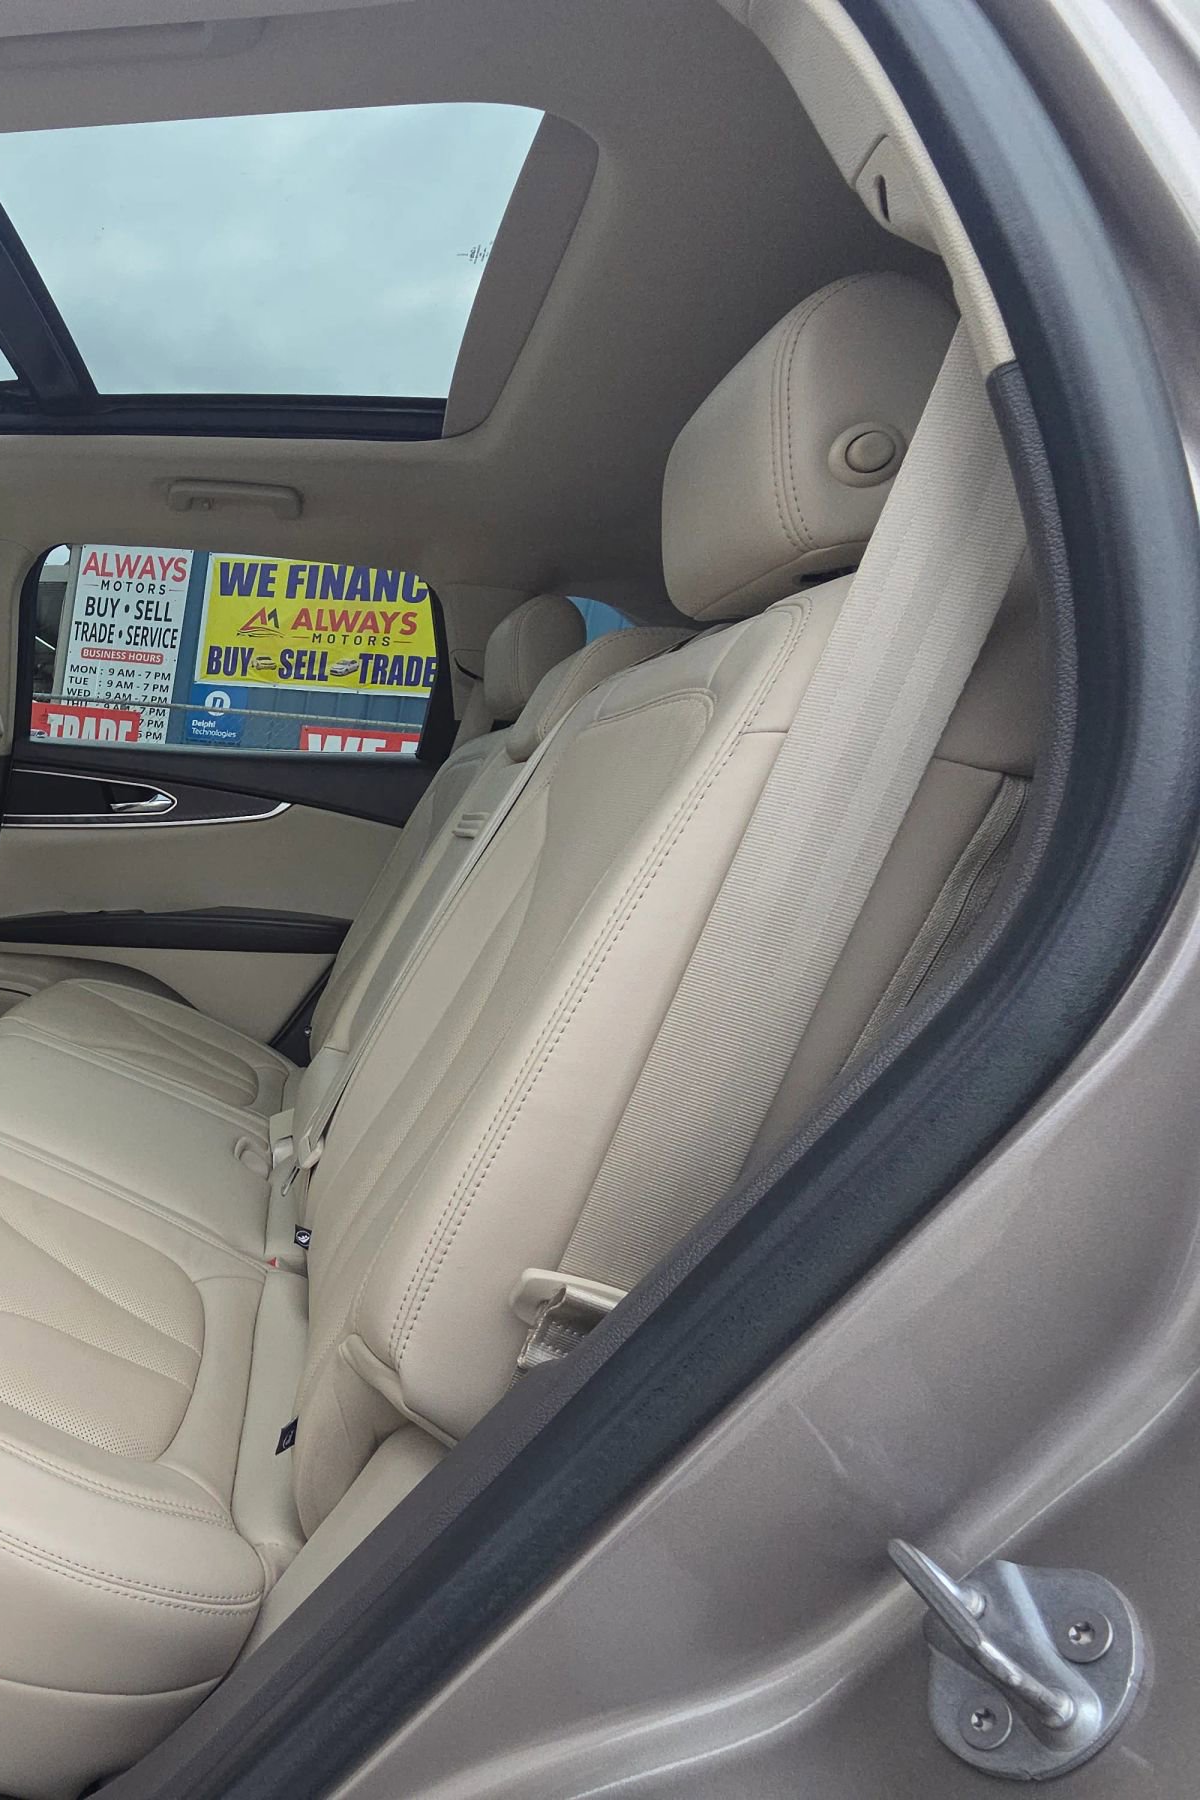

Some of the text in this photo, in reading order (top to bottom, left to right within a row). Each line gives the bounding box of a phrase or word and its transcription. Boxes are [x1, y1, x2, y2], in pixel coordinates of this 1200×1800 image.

[82, 552, 188, 582] ALWAYS
[101, 580, 166, 595] MOTORS
[219, 561, 428, 604] WE FINANC
[84, 596, 172, 622] BUY SELL
[290, 607, 418, 636] ALWAYS
[74, 621, 178, 649] TRADE SERVICE
[311, 633, 391, 647] MOTORS
[82, 650, 162, 663] BUSINESS HOURS
[206, 646, 438, 688] BUY SELL TRADE
[108, 668, 115, 676] 9
[117, 669, 135, 678] AM
[144, 671, 151, 679] 7
[154, 672, 171, 681] PM
[69, 676, 89, 686] TUE
[106, 680, 113, 688] 9
[115, 681, 133, 690] AM
[143, 683, 150, 691] 7
[152, 684, 169, 693] PM
[66, 687, 91, 697] WED
[105, 692, 112, 700] 9
[139, 706, 146, 715] 7
[149, 708, 165, 717] PM
[147, 720, 164, 729] PM
[192, 719, 217, 728] Delphi
[145, 731, 162, 741] PM
[192, 727, 237, 739] Technologies
